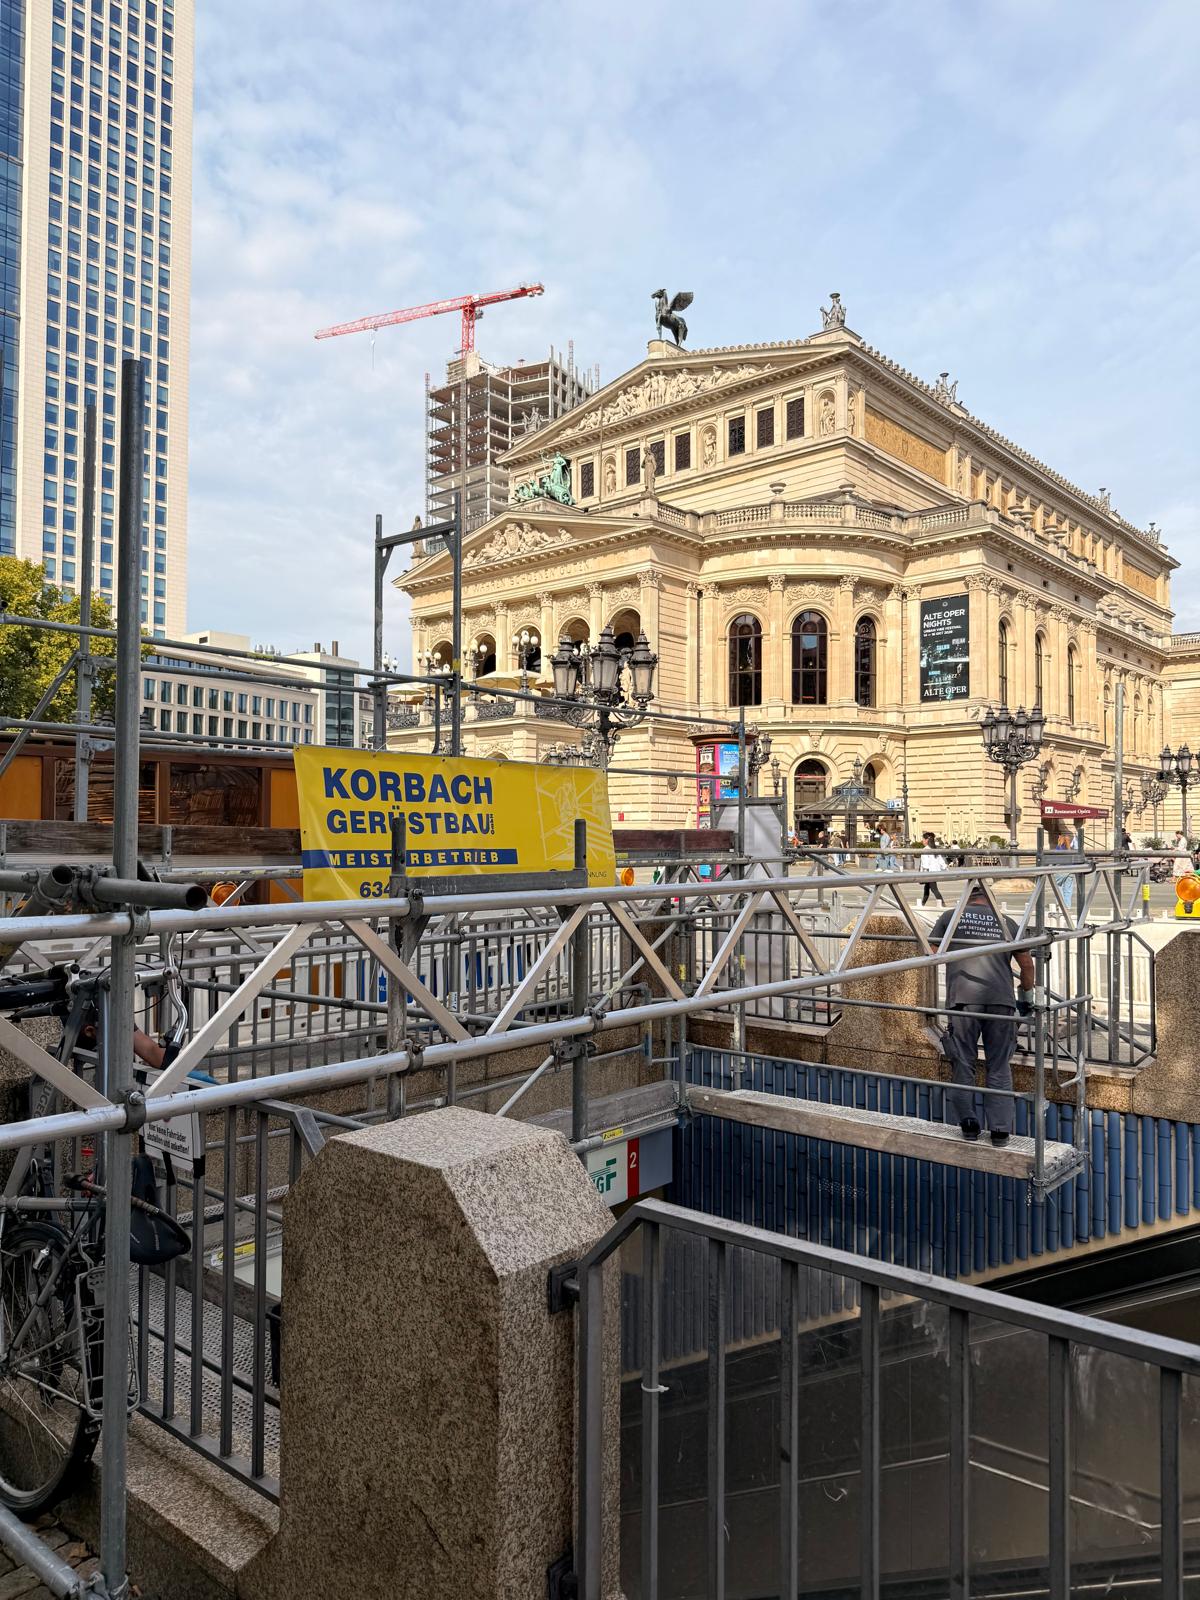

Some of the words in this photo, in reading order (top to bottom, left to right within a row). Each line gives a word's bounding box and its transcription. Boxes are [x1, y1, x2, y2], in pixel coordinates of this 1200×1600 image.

[923, 611, 942, 621] ALTE
[943, 609, 966, 618] OPER
[923, 618, 952, 629] NIGHTS
[923, 687, 944, 697] ALTE
[945, 685, 967, 695] OPER
[322, 767, 493, 805] KORBACH
[329, 851, 499, 866] MEISTRBETRIEB
[629, 1151, 637, 1169] 2
